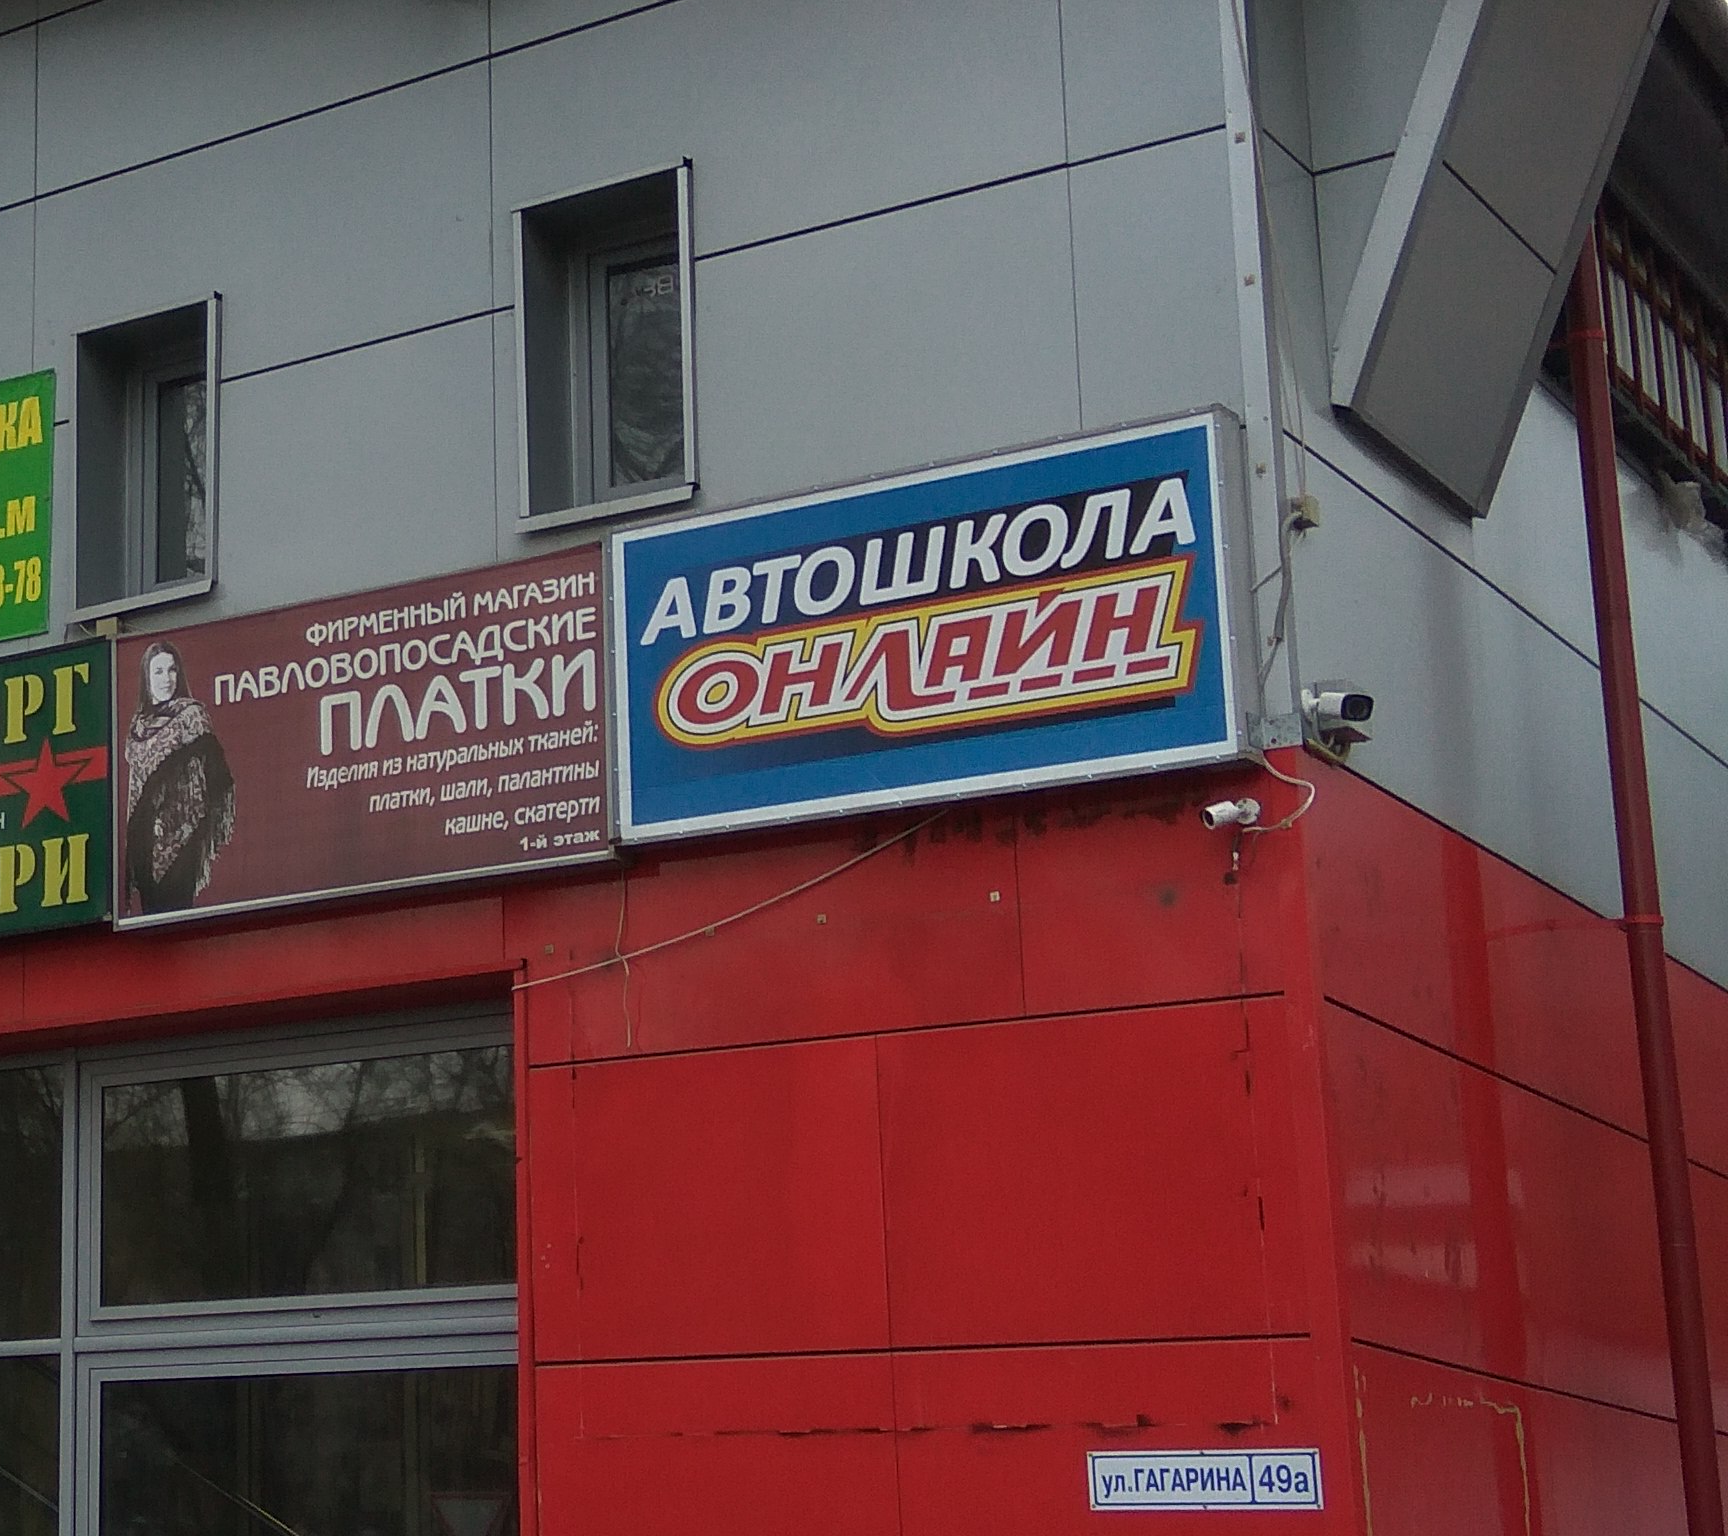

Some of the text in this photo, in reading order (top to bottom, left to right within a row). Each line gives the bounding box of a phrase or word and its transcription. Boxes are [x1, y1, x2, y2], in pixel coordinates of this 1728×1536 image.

[639, 477, 1197, 647] АВТОШКОЛА
[306, 571, 596, 647] ФИРМЕННЫЙ МАГАЗИН
[215, 606, 597, 706] ПАВЛОВОПОСАДСКИЕ
[320, 648, 596, 756] ПЛАТКИ
[306, 720, 599, 791] Изделия из натуральных тканей:
[369, 760, 600, 813] платки, шали, палантины
[445, 795, 600, 837] кашне, скатерти
[519, 828, 600, 852] 1-й этаж
[1101, 1467, 1247, 1499] ул.ГАГАРИНА
